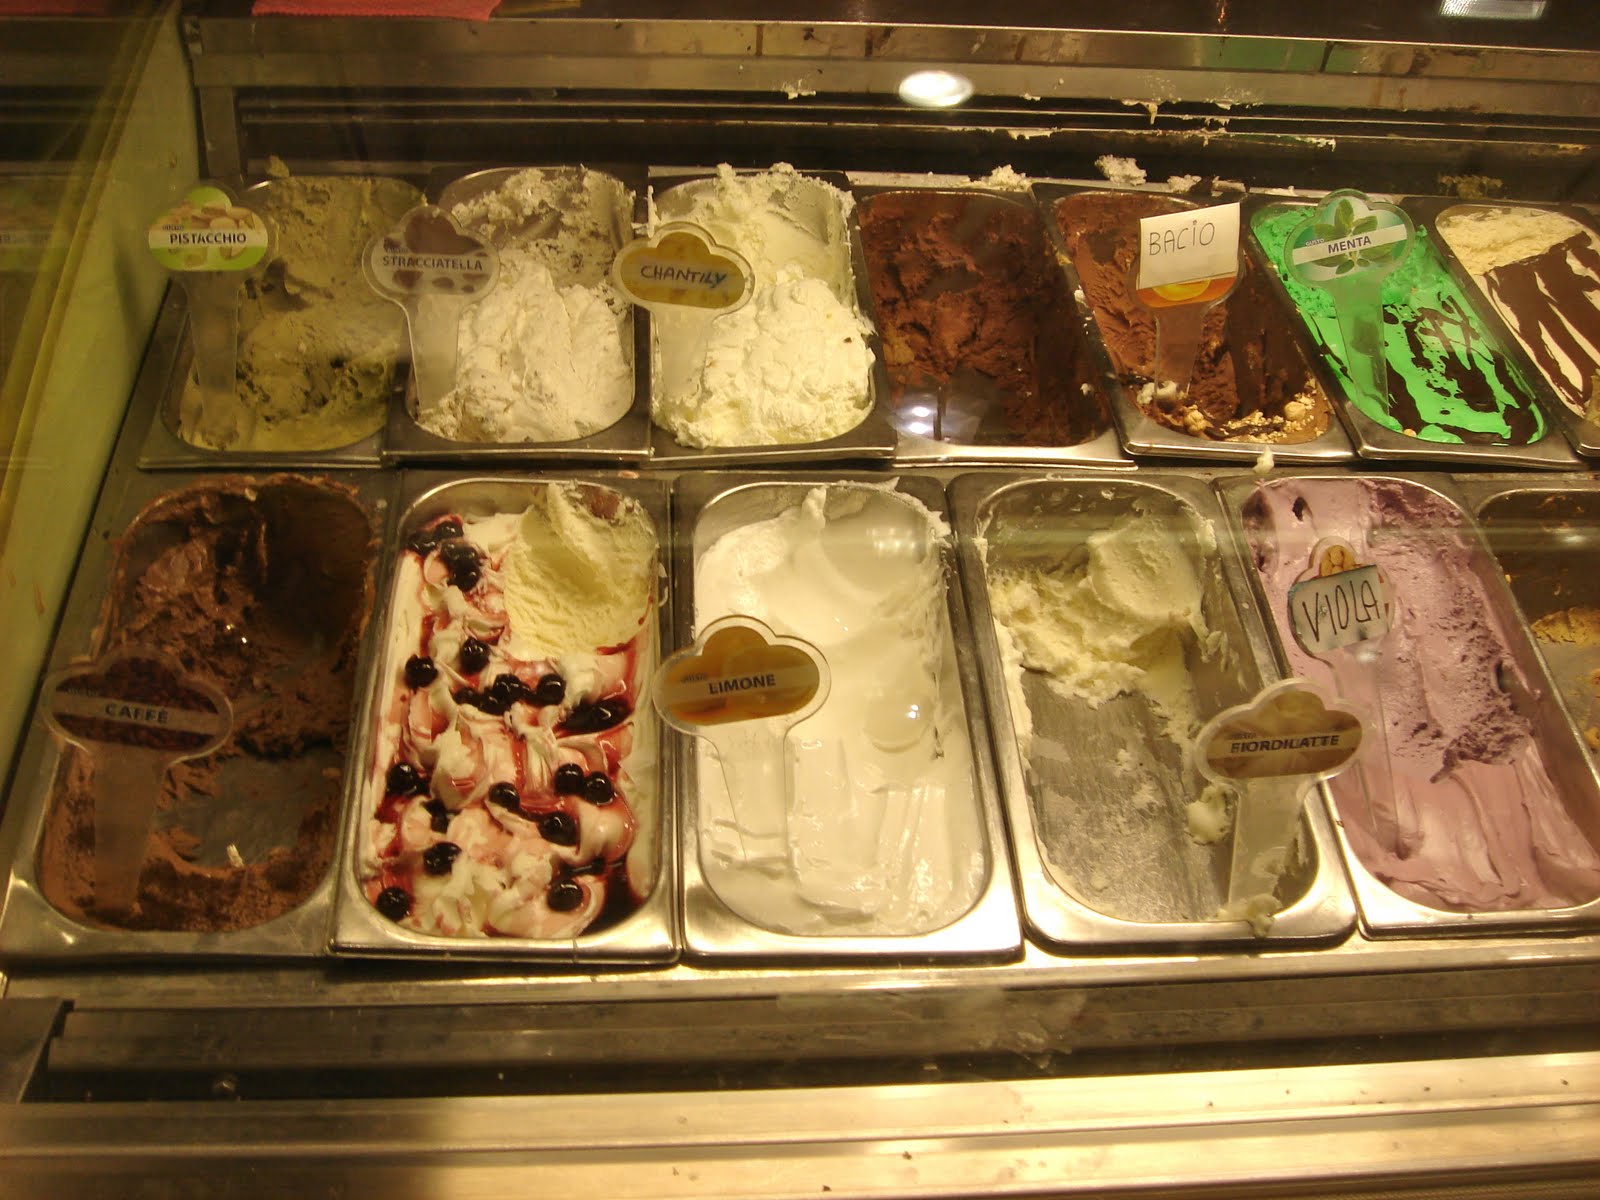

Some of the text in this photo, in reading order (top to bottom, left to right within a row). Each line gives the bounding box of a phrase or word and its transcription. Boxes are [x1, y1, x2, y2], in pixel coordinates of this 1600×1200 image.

[169, 232, 247, 244] PISTACCHIO
[1327, 235, 1372, 254] MENTA
[382, 256, 483, 271] STRACCIATELLA
[1302, 579, 1381, 642] VIOLA
[708, 673, 776, 695] LIMONE
[1230, 734, 1341, 754] FIORDILATTE
